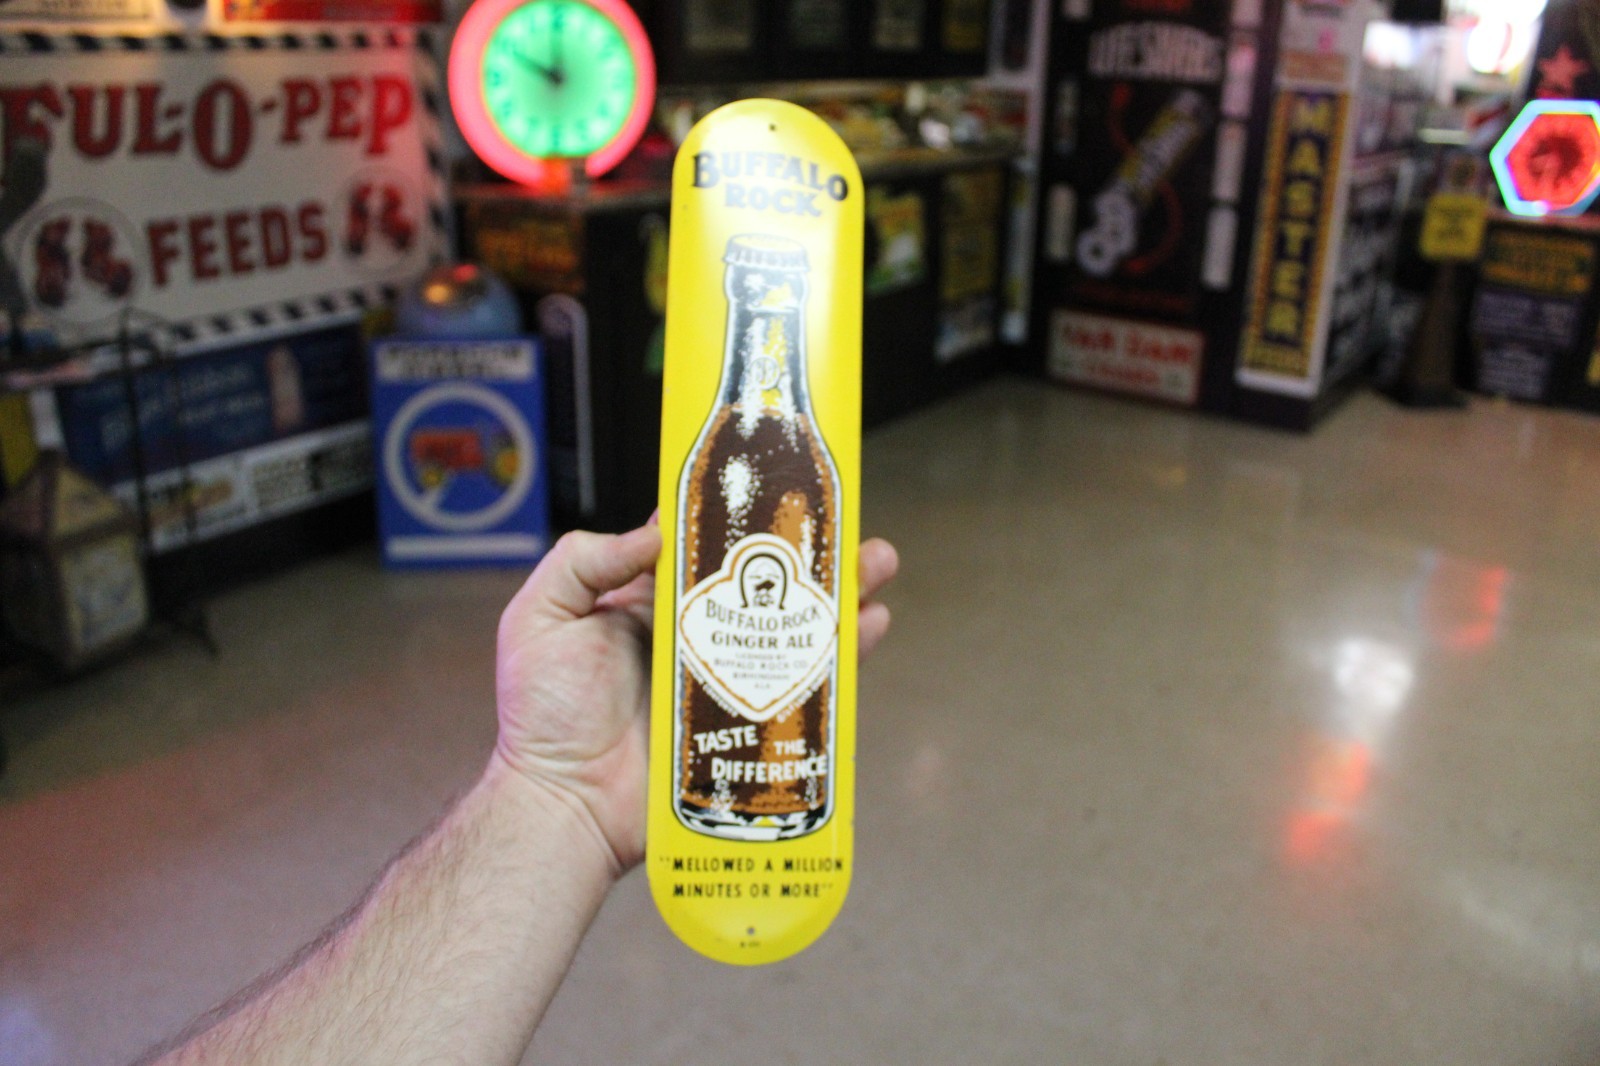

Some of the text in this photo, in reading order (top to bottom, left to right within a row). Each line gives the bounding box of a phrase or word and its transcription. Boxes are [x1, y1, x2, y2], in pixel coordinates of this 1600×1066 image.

[692, 151, 849, 202] BUFFALO
[725, 183, 822, 218] ROCK
[146, 203, 329, 288] FEEDS
[706, 598, 822, 632] BUFFALO ROCK
[711, 630, 814, 649] GINGER ALE
[714, 658, 755, 670] BUFFALO
[760, 662, 789, 671] ROCK
[693, 725, 807, 756] TASTE THE
[711, 756, 828, 783] DIFFERENCE
[764, 859, 773, 871] A
[783, 857, 844, 871] MILLION
[673, 883, 742, 898] MINUTES
[750, 884, 771, 898] OR
